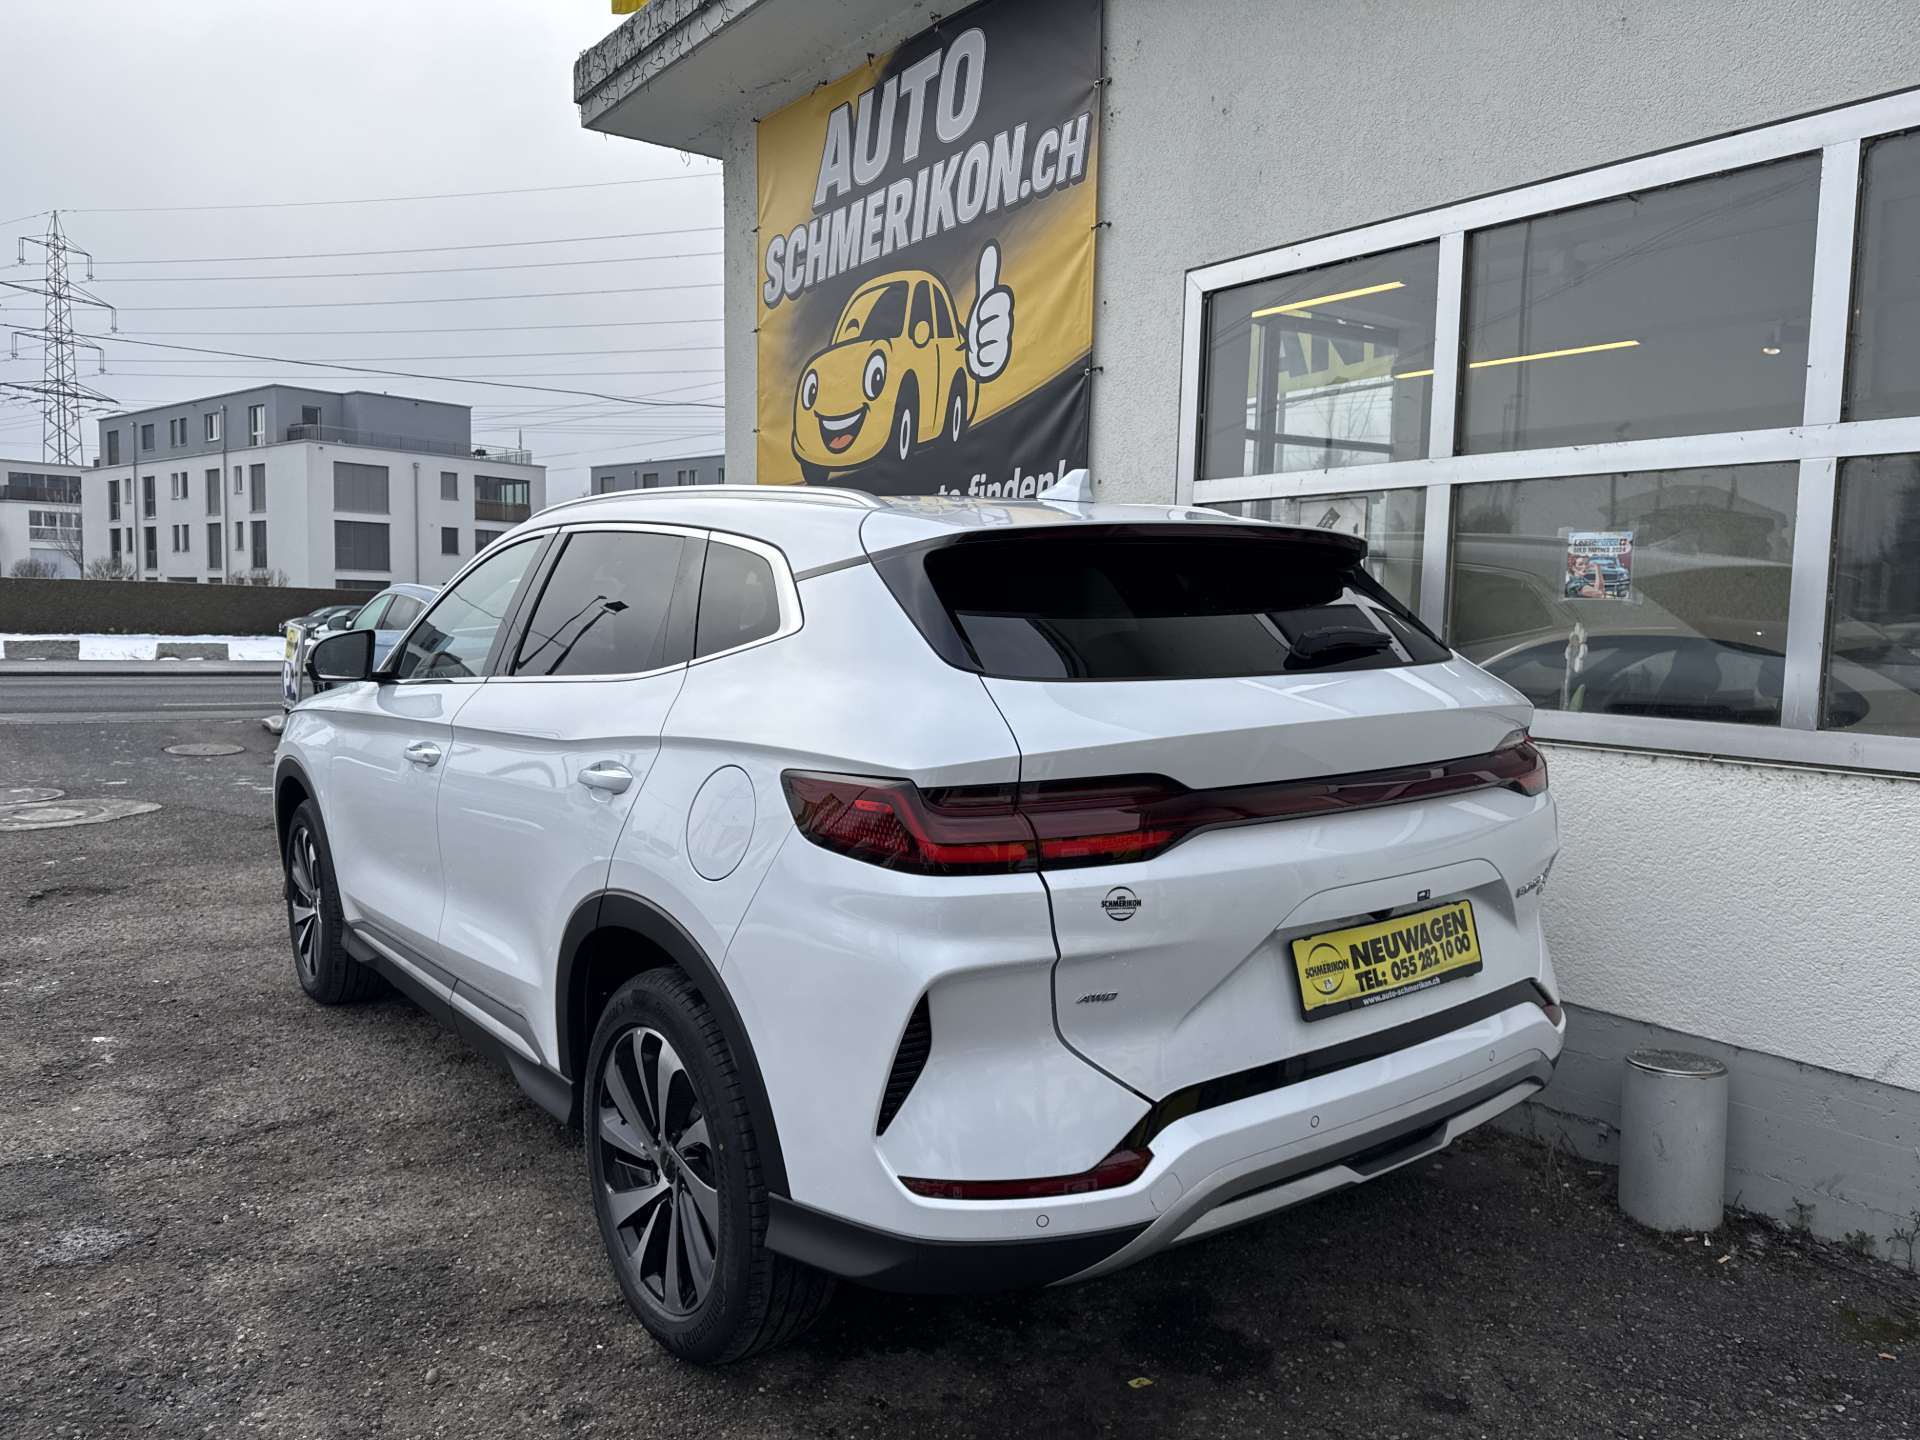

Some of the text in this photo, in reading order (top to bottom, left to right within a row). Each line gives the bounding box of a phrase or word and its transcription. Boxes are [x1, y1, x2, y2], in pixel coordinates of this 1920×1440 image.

[813, 27, 987, 208] AUTO
[763, 112, 1091, 301] SCHMERIKON.CH
[1101, 899, 1142, 908] SCHMERIKON
[1305, 958, 1350, 979] SCHMERIKON
[1349, 909, 1469, 970] NEUWAGEN
[1354, 933, 1472, 992] TEL: 055 282 10 00
